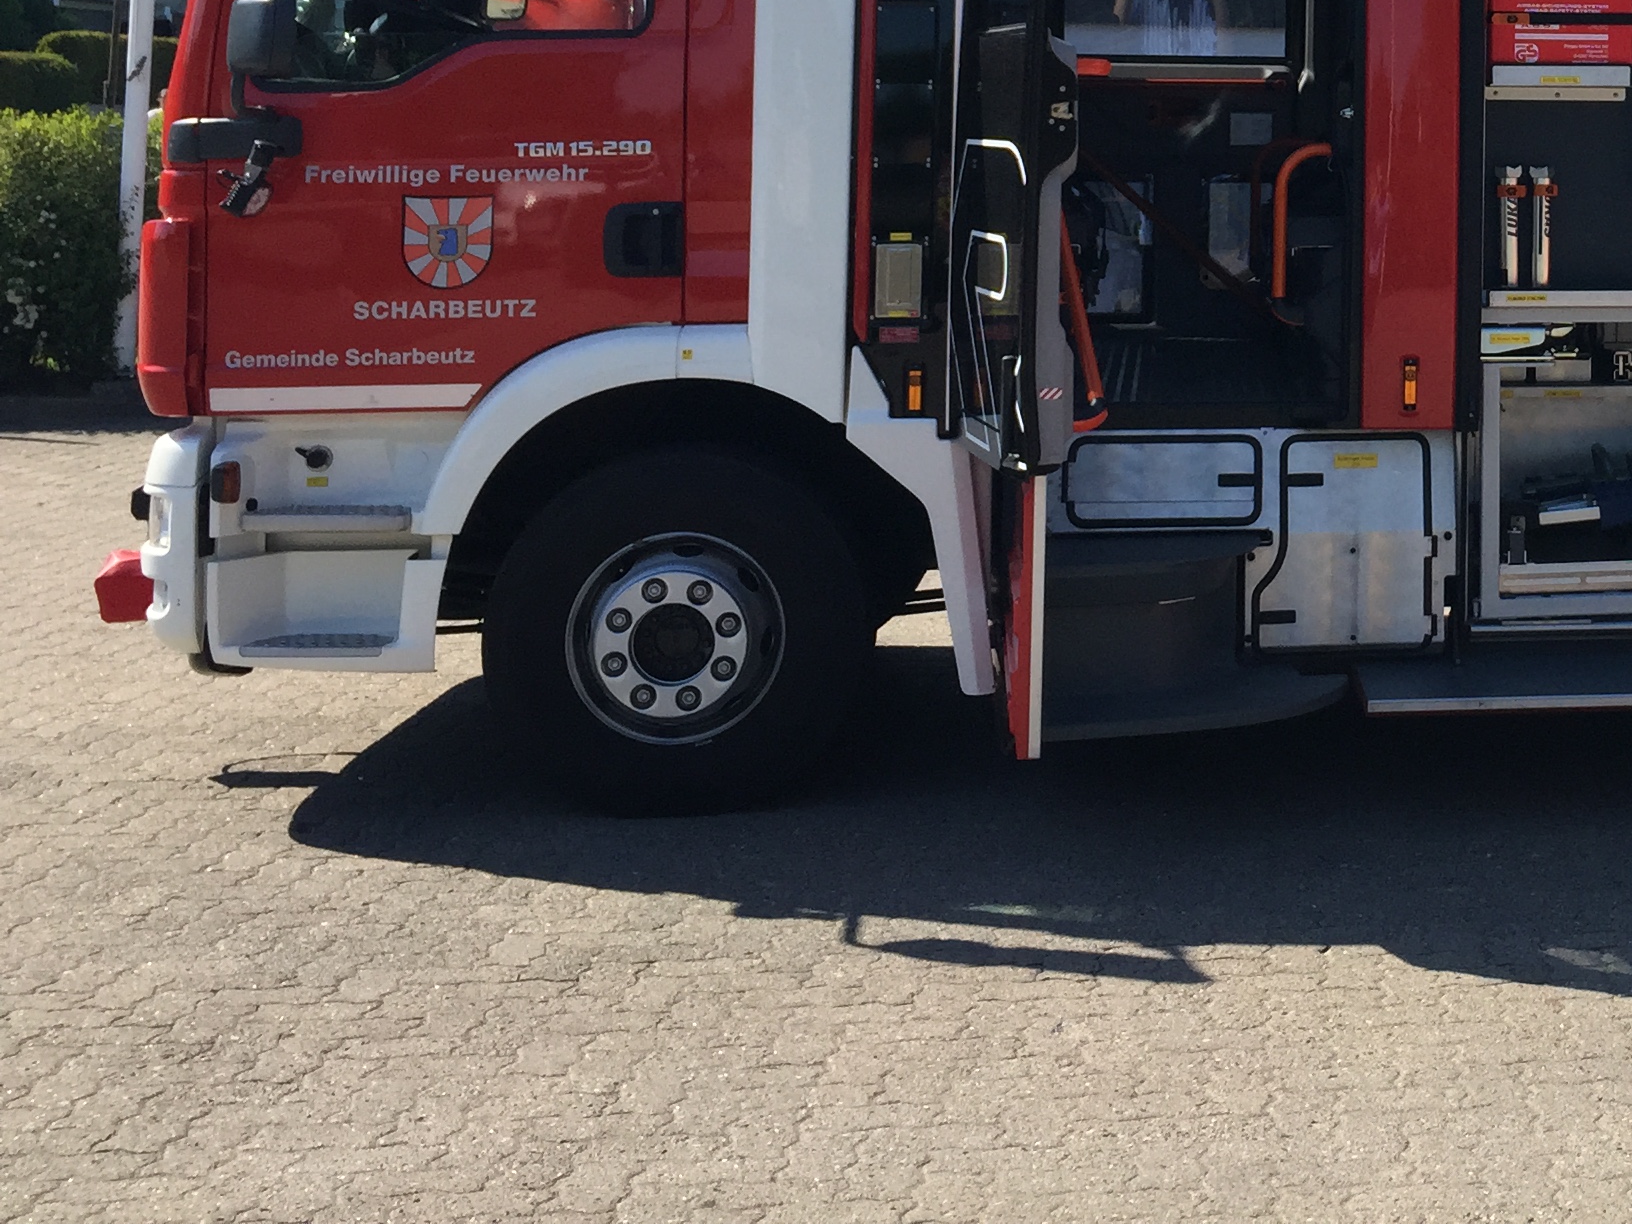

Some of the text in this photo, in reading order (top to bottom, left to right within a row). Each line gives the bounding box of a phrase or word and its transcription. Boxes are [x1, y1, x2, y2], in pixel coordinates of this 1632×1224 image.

[514, 140, 653, 158] TGM 15.290
[304, 164, 589, 187] Freiwillige Feuerwehr
[1506, 185, 1518, 238] LUKA
[353, 299, 537, 321] SCHARBEUTZ
[224, 347, 476, 369] Gemeinde Scharbeutz
